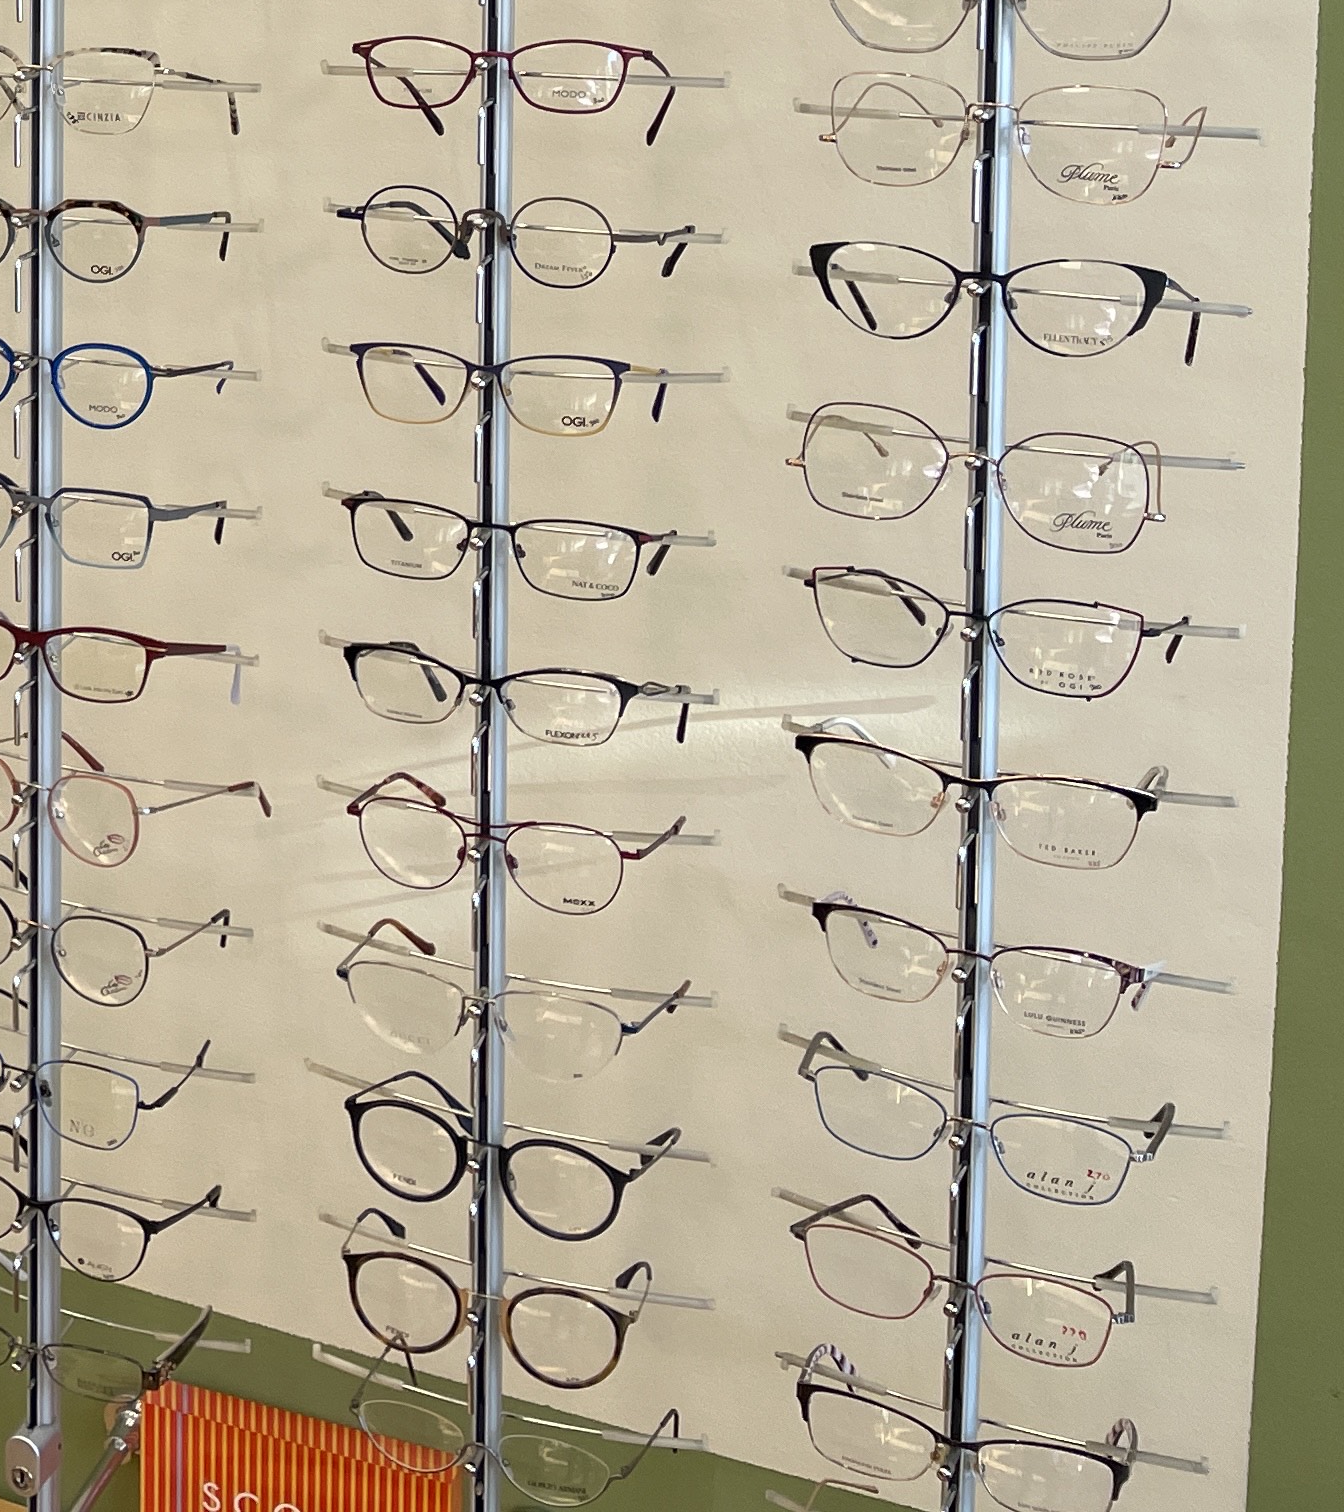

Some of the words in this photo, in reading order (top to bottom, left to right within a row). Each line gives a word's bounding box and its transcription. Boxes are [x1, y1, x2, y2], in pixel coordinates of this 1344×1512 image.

[552, 89, 587, 99] MODO
[85, 111, 121, 122] CINZIA
[1057, 162, 1120, 184] Plume
[90, 264, 113, 275] OGI
[88, 404, 118, 413] MODO
[561, 415, 589, 428] OGI
[1049, 510, 1113, 532] Plume
[111, 551, 135, 562] OGI
[1023, 1010, 1043, 1020] LULU
[1045, 1014, 1086, 1028] GUINNESS
[1026, 1171, 1074, 1188] alan
[1085, 1180, 1097, 1194] j
[1087, 1169, 1111, 1181] 270
[1026, 1182, 1095, 1201] COLLECTION
[1011, 1331, 1057, 1349] alan
[1068, 1343, 1079, 1356] j
[1011, 1343, 1078, 1362] COLLECTION
